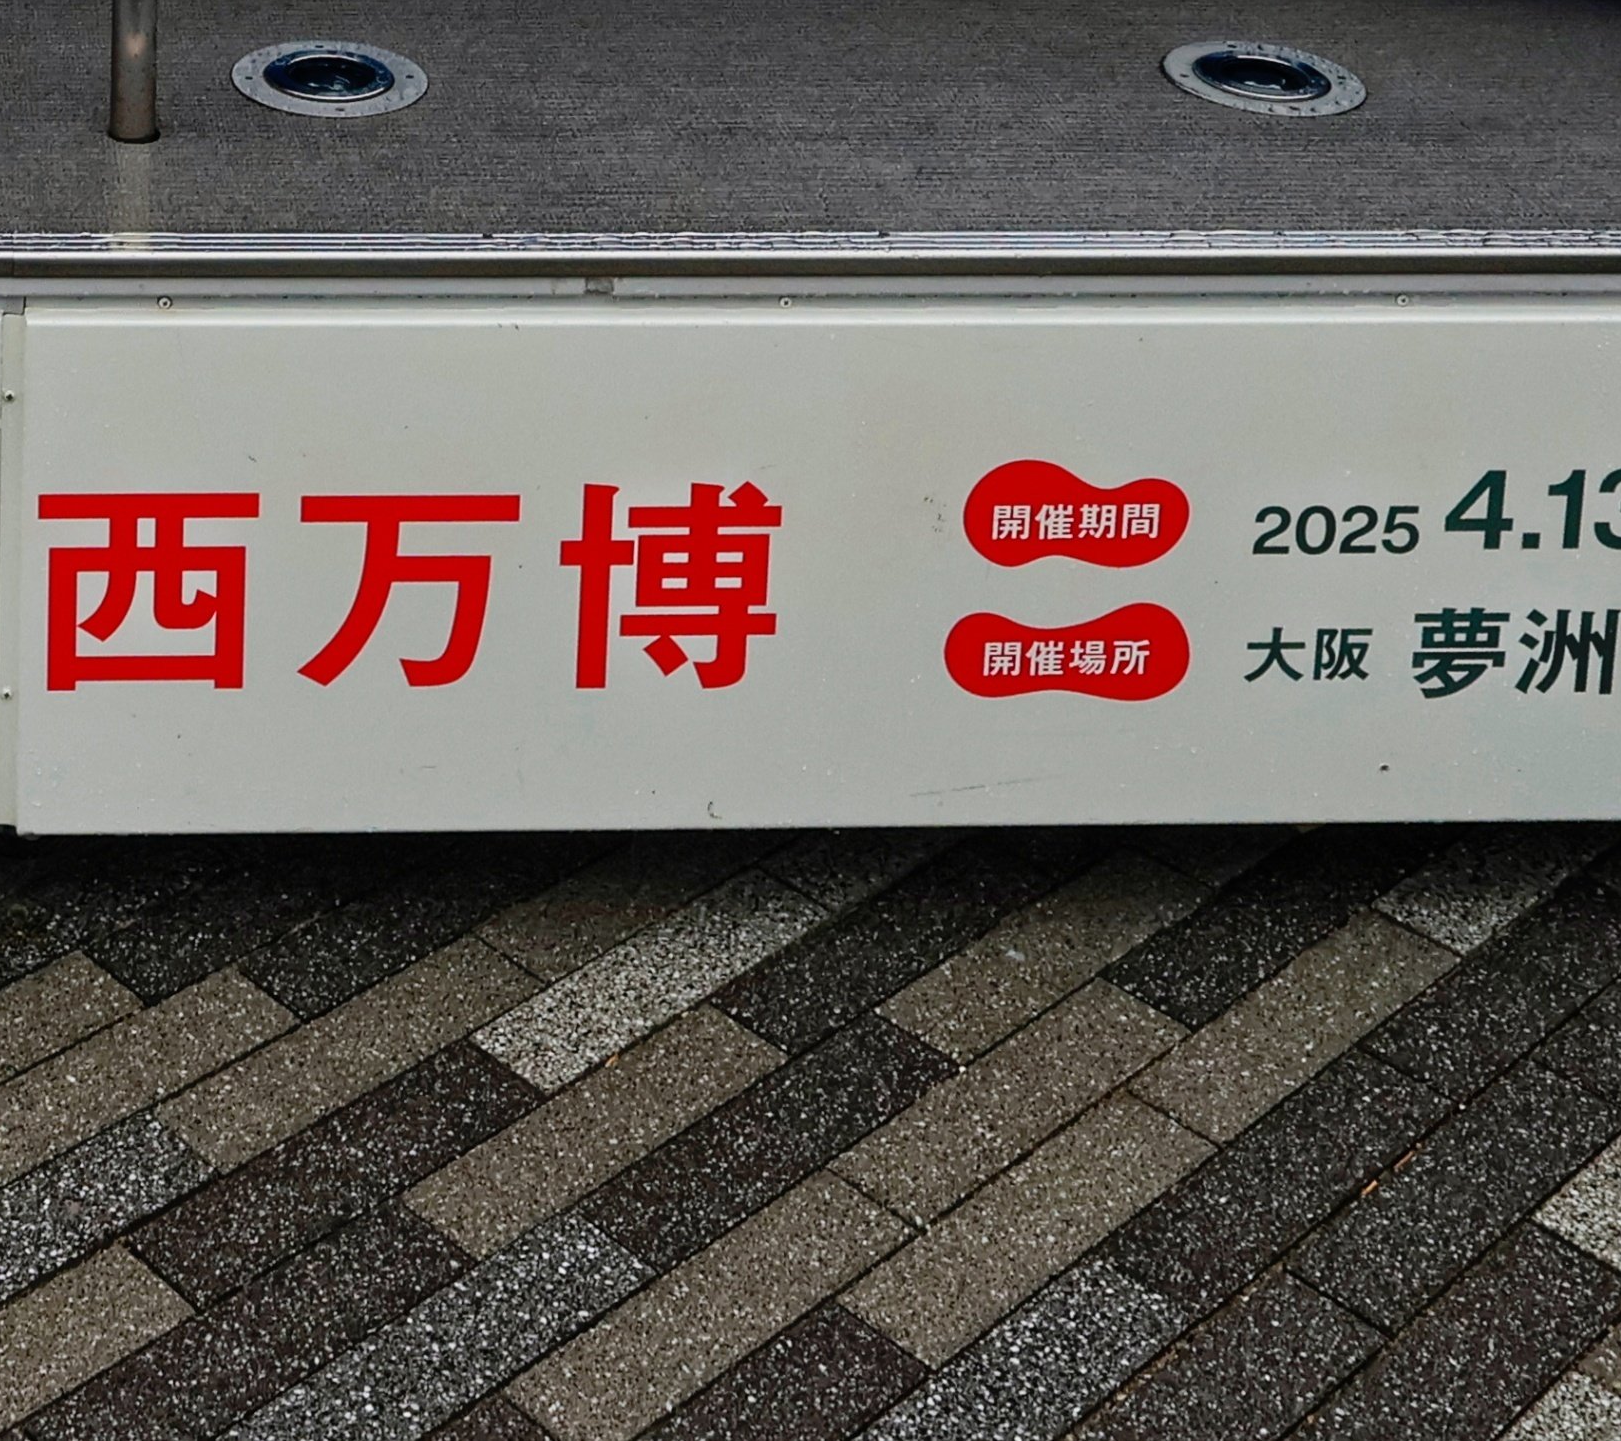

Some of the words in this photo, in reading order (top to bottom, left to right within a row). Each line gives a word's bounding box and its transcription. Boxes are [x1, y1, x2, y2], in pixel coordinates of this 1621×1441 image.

[991, 503, 1161, 540] 開催期間
[1252, 505, 1421, 555] 2025
[982, 638, 1151, 677] 開催場所
[1243, 627, 1374, 682] 大阪
[1411, 607, 1621, 699] 夢洲
